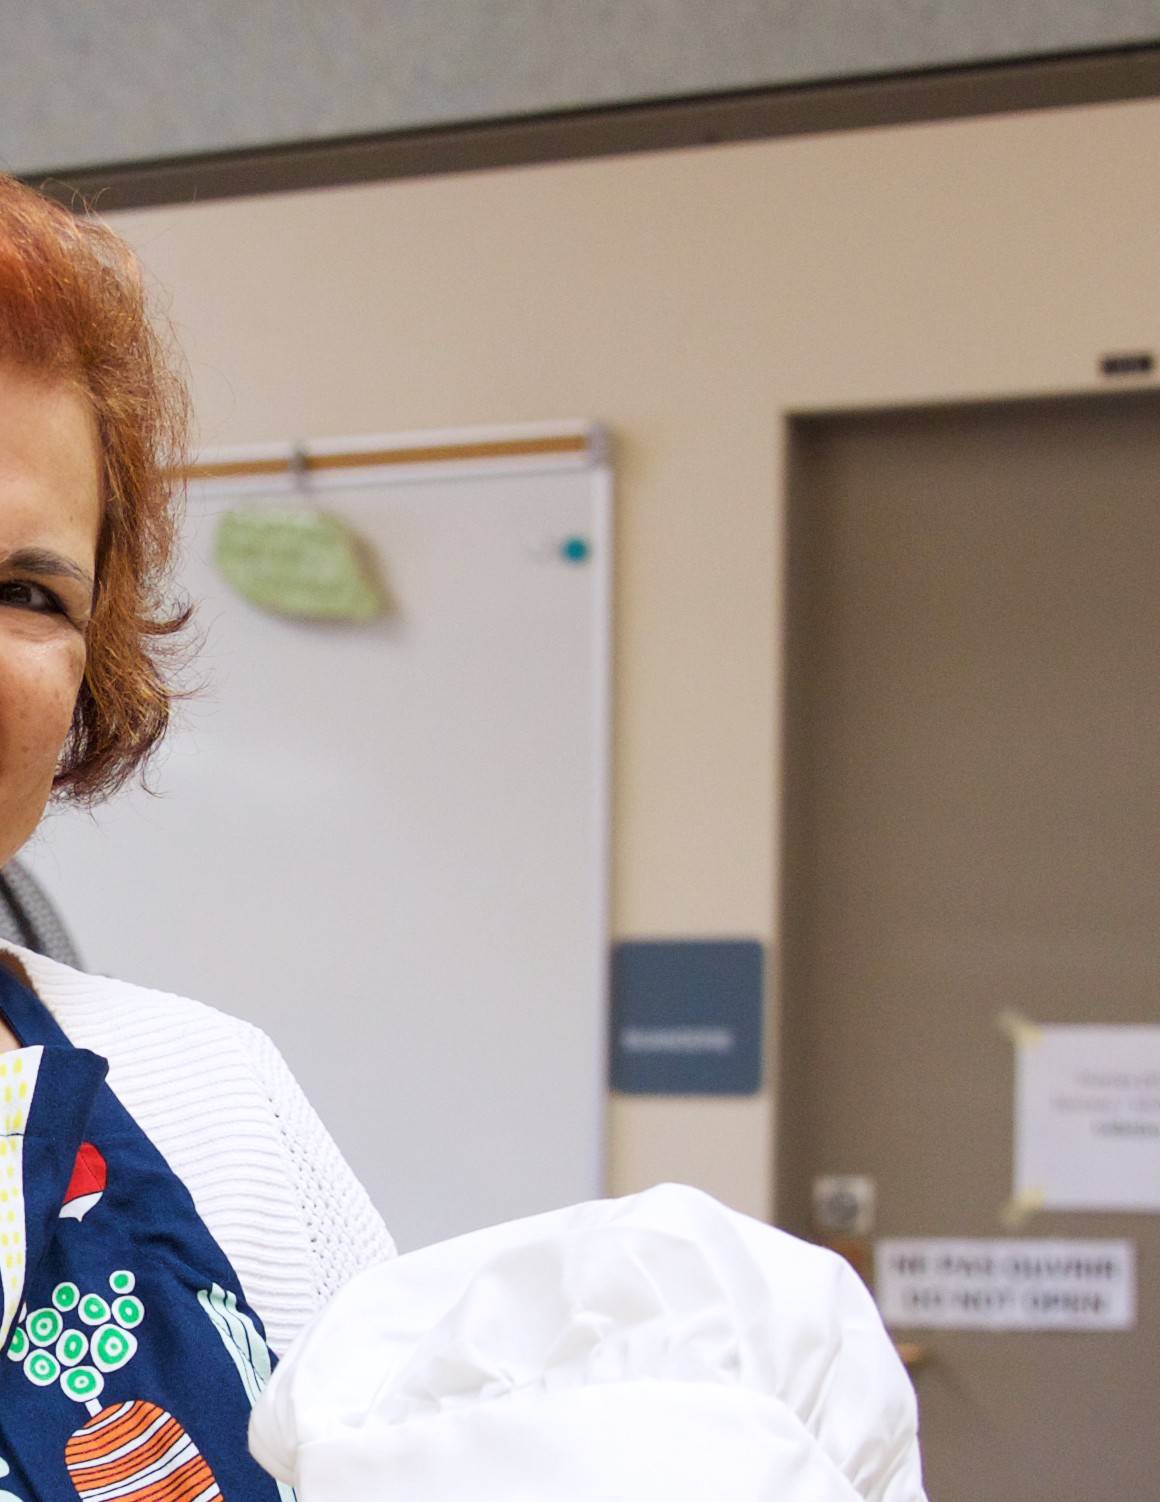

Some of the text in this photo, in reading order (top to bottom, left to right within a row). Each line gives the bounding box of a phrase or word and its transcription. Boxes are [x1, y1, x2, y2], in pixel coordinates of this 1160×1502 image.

[939, 1256, 996, 1278] PAS
[907, 1290, 1110, 1316] DO NOT OPEN
